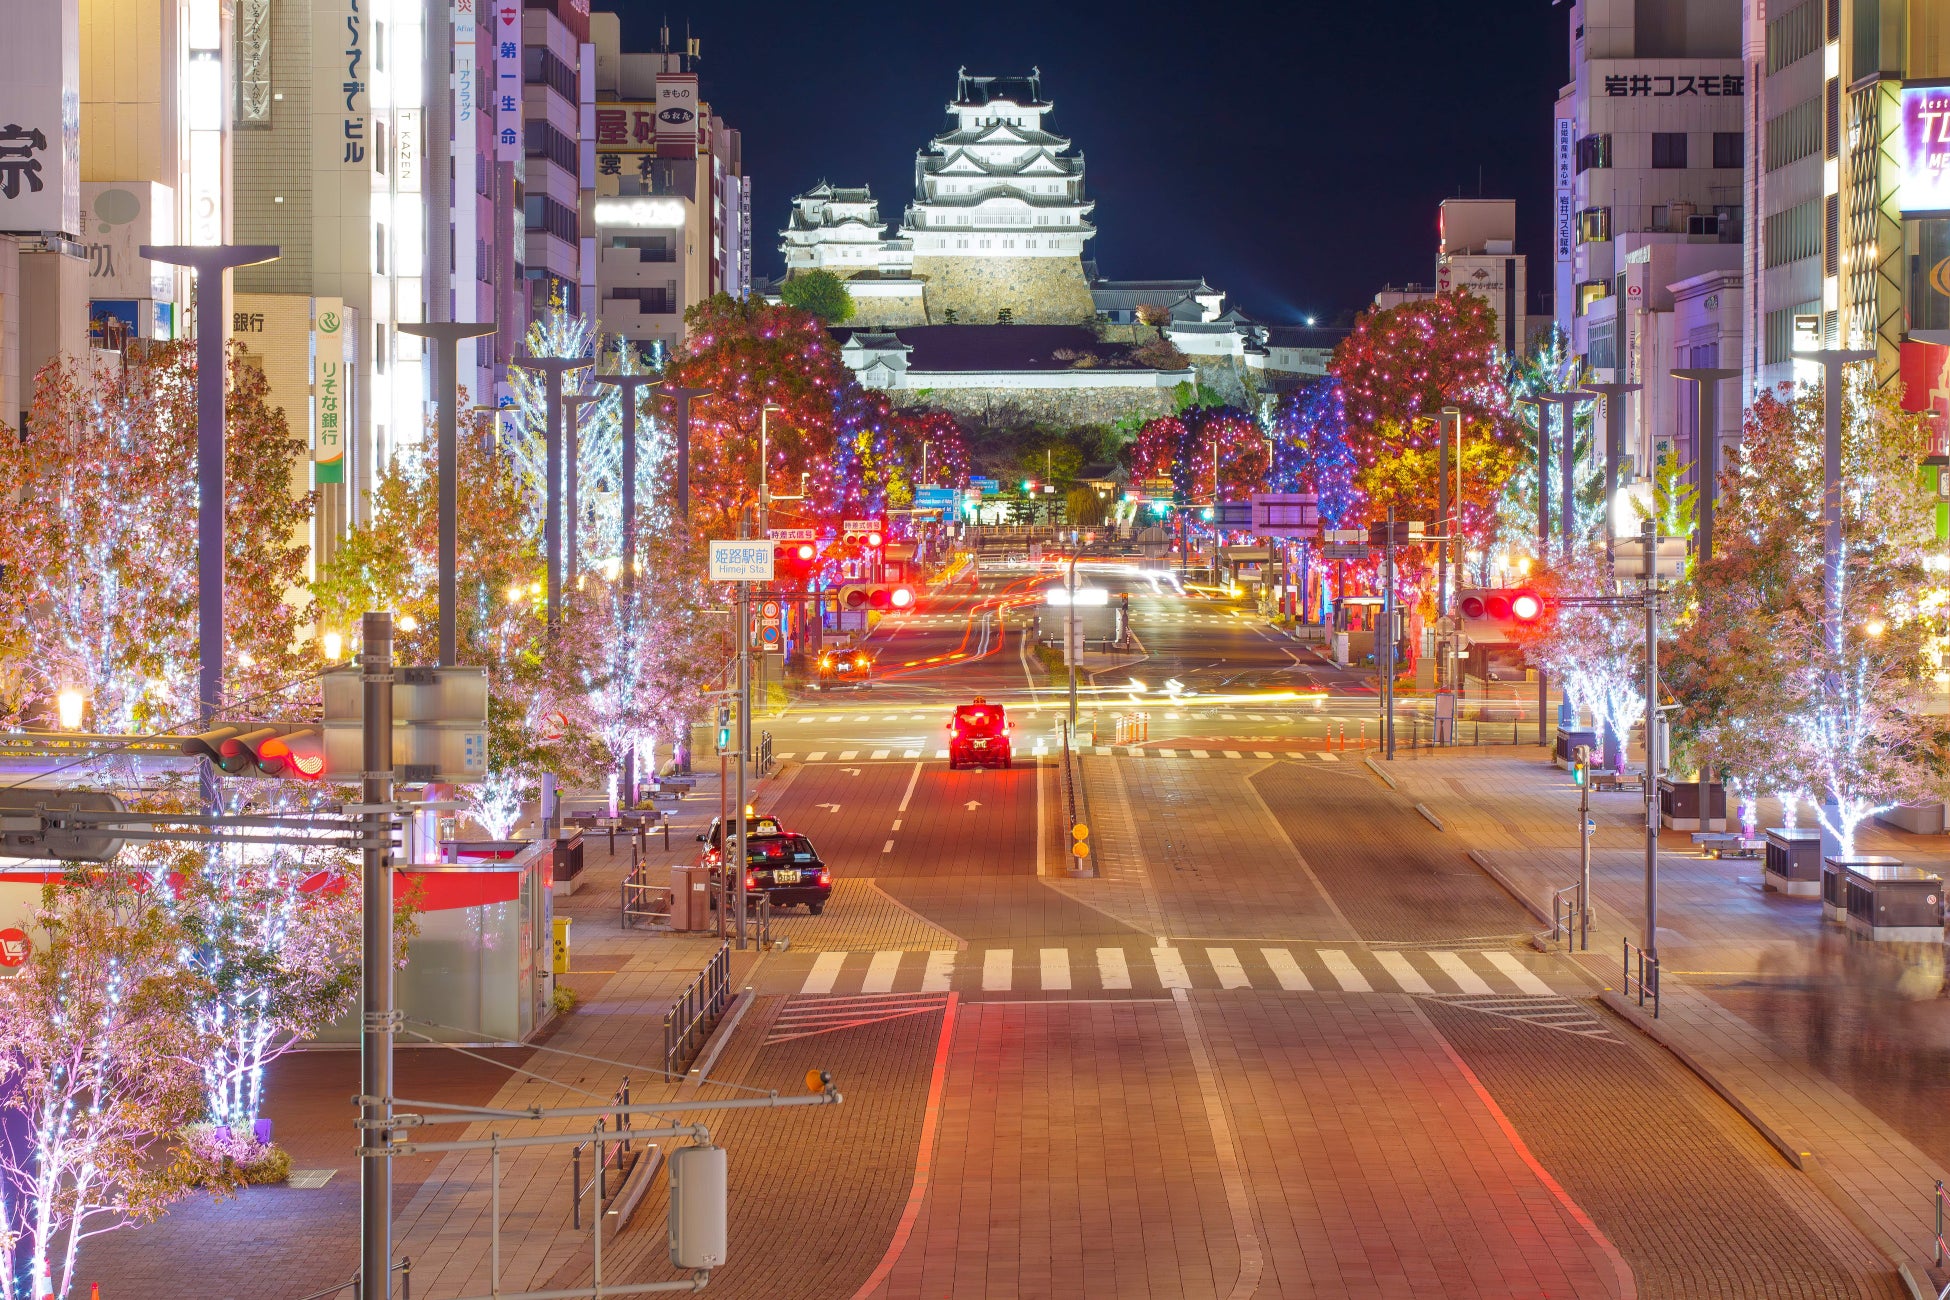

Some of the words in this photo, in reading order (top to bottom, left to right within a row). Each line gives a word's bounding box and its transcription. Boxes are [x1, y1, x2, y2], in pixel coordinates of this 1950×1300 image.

[501, 42, 517, 145] 第一生命
[662, 89, 690, 98] きもの
[1605, 75, 1744, 96] 岩井コスモ証
[460, 71, 471, 121] アフラック
[1560, 196, 1568, 254] 岩井コスモ証券
[233, 313, 264, 333] 銀行
[322, 362, 337, 446] りそな銀行
[771, 531, 813, 539] 時差式信号
[715, 549, 768, 564] 姫路駅前
[719, 565, 746, 575] Himeji
[749, 565, 767, 574] Sta.
